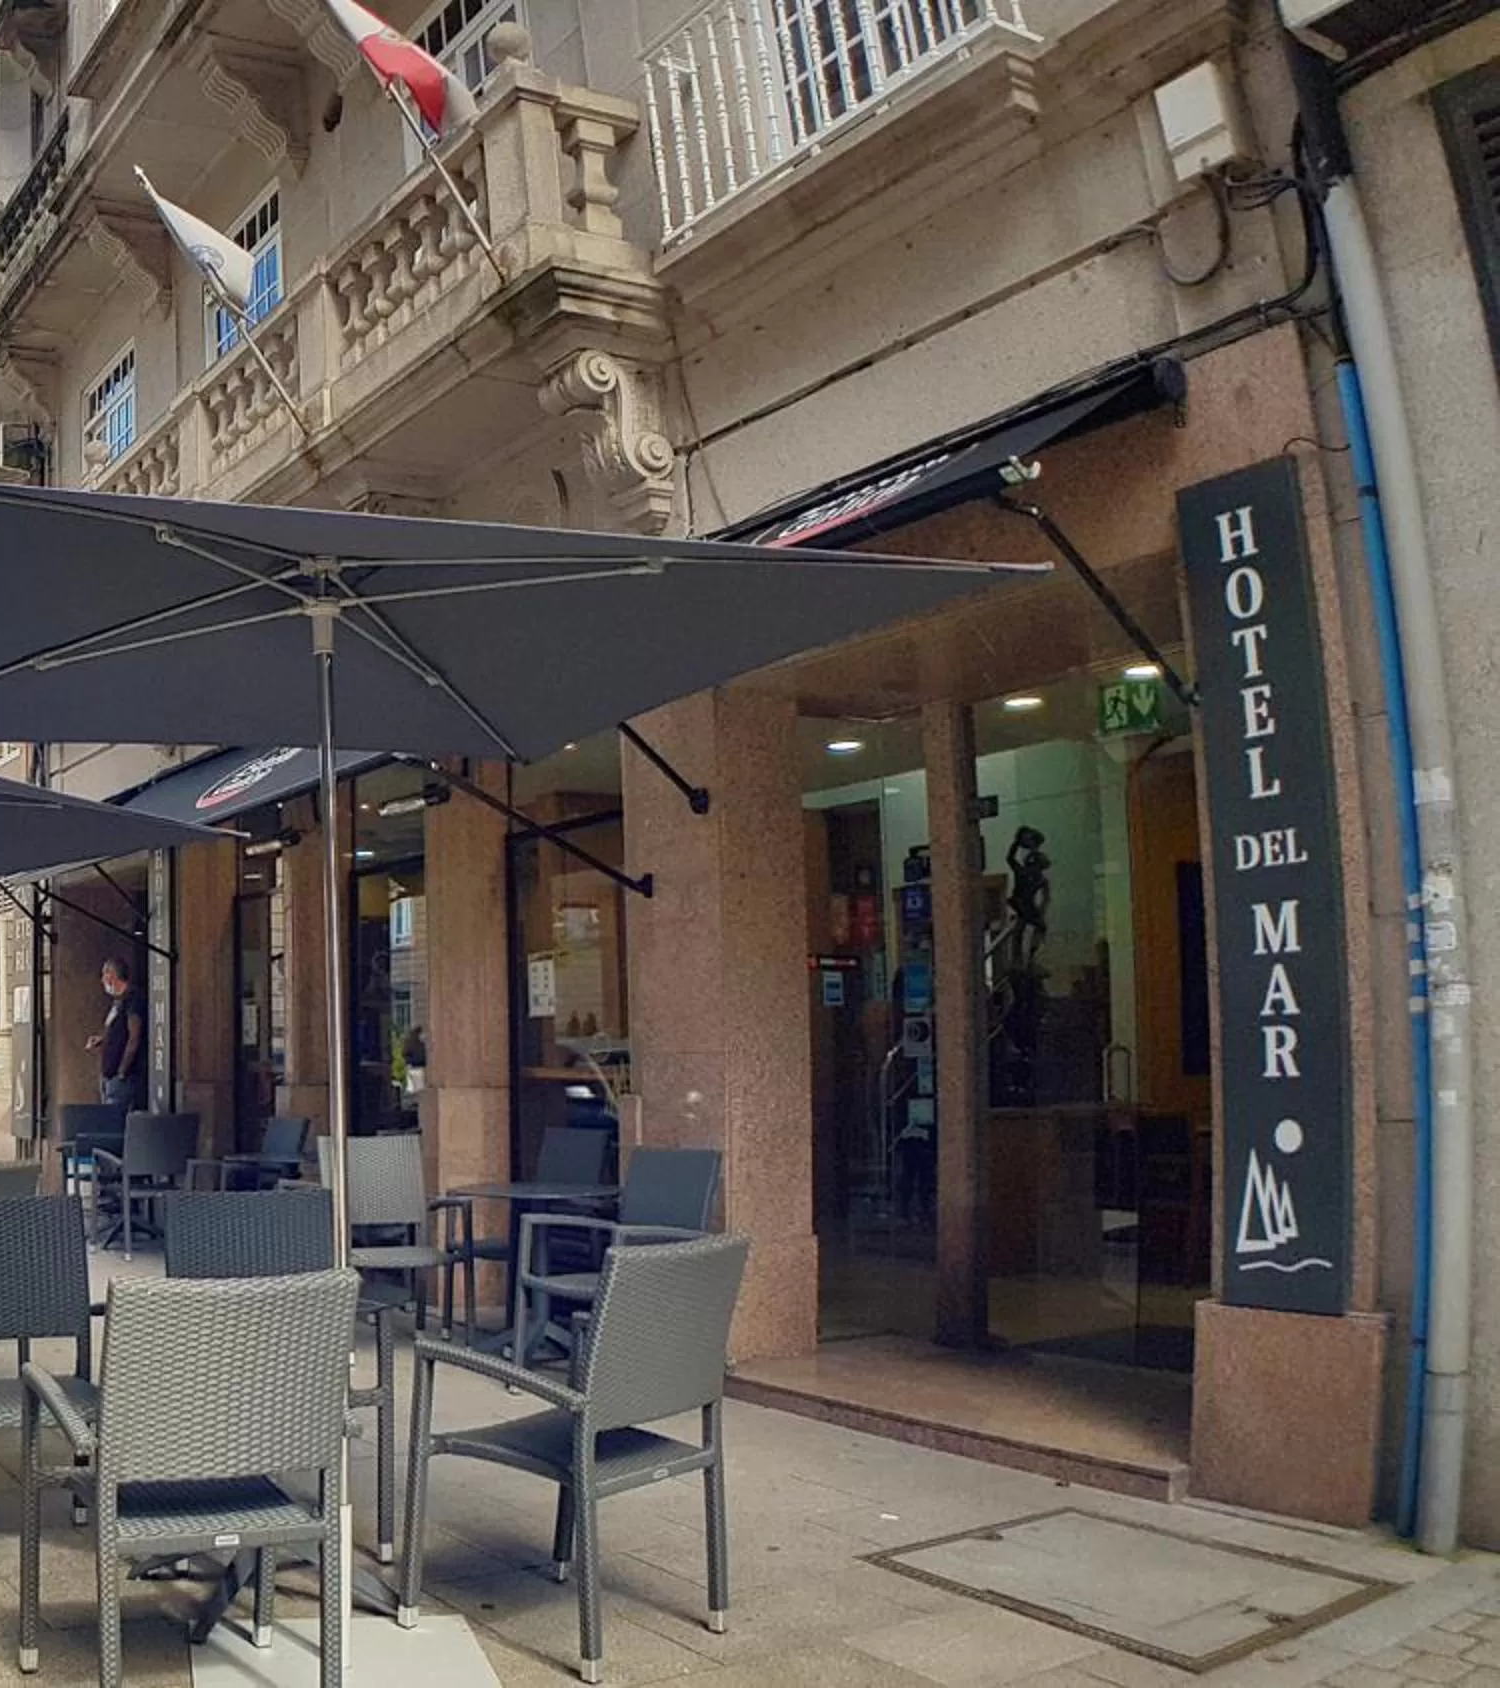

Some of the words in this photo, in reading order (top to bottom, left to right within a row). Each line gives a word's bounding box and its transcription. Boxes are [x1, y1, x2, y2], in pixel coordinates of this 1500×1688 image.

[1214, 505, 1281, 799] HOTEL
[1234, 827, 1308, 871] DEL
[1251, 899, 1302, 1078] MAR
